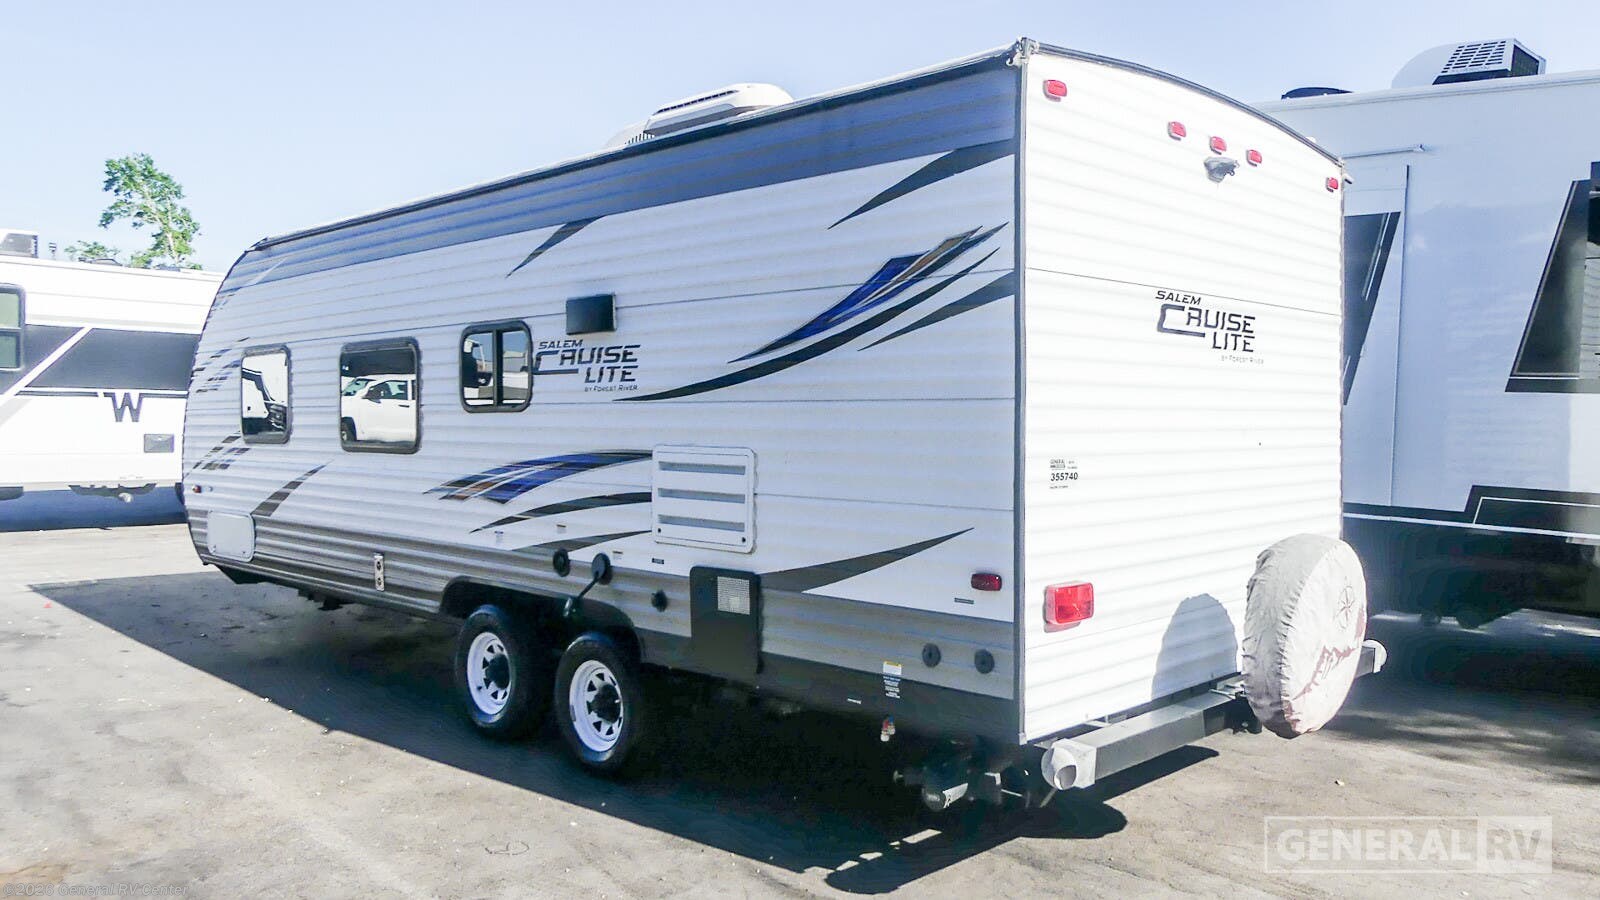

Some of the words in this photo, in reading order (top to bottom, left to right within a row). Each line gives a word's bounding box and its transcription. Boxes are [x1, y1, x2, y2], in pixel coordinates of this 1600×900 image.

[1155, 290, 1202, 305] SALEM
[1157, 303, 1256, 338] CRUISE
[538, 339, 584, 350] SALEM
[1212, 331, 1255, 353] LITE
[532, 344, 641, 375] CRUISE
[584, 365, 639, 384] LITE
[103, 392, 143, 423] W
[1050, 472, 1078, 481] 355740
